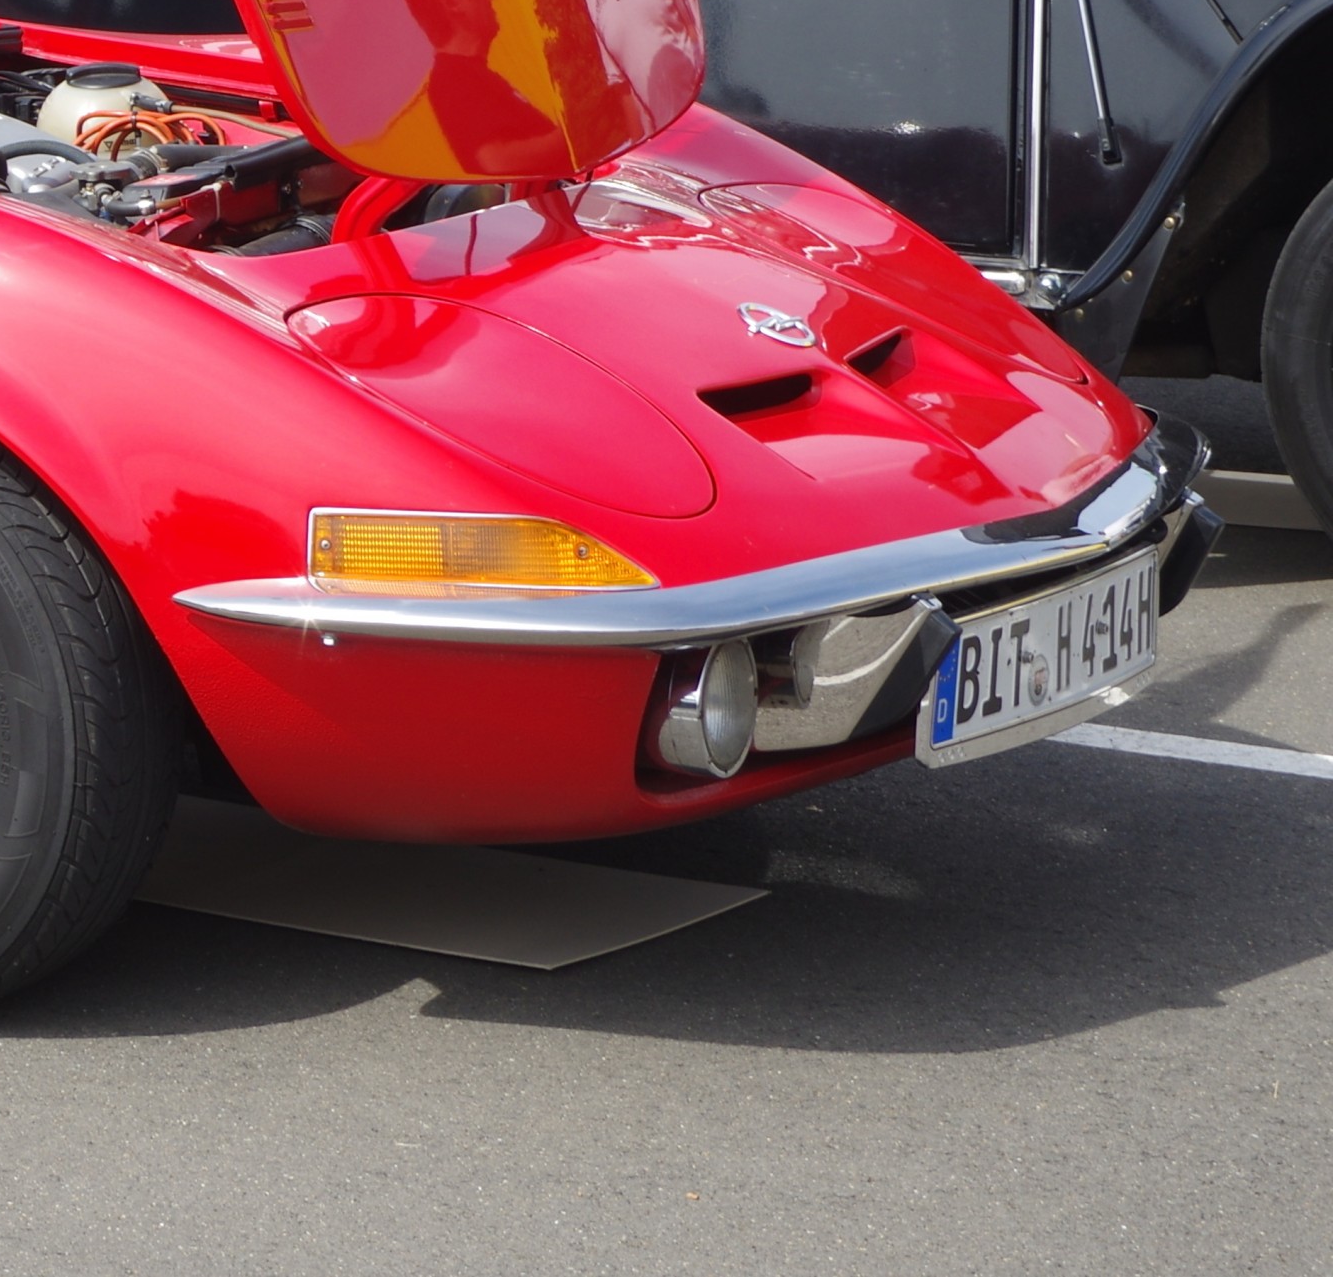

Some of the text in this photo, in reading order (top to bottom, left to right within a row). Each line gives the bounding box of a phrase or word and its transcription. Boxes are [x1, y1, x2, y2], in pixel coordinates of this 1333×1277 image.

[937, 566, 1153, 725] D BIT H 414H
